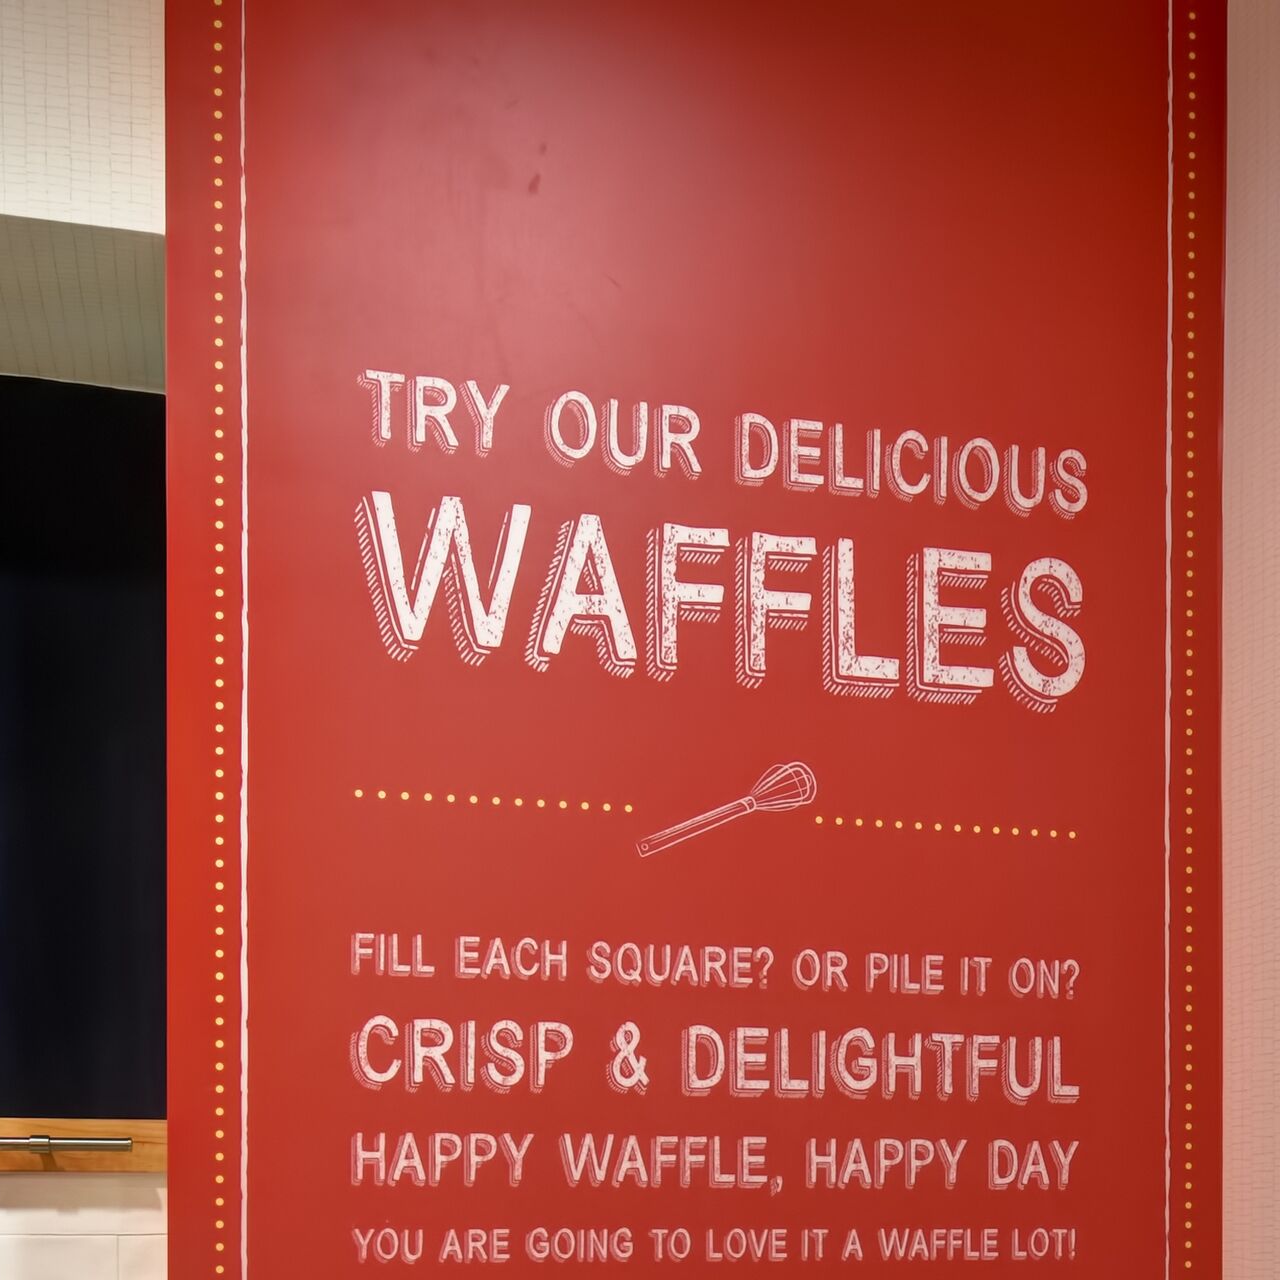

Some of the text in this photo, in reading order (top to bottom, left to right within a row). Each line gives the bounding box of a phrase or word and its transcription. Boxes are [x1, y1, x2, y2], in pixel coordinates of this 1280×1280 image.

[357, 369, 1087, 519] TRY OUR DELICIOUS
[354, 489, 1087, 713] WAFFLES
[351, 933, 1079, 999] FILL EACH SQUARE? OR PILE IT ON?
[350, 1015, 1079, 1105] CRISP & DELIGHTFUL
[351, 1132, 1079, 1196] HAPPY WAFFLE, HAPPY DAY
[352, 1227, 1075, 1264] YOU ARE GOING TO LOVE IT A WAFFLE LOT!
